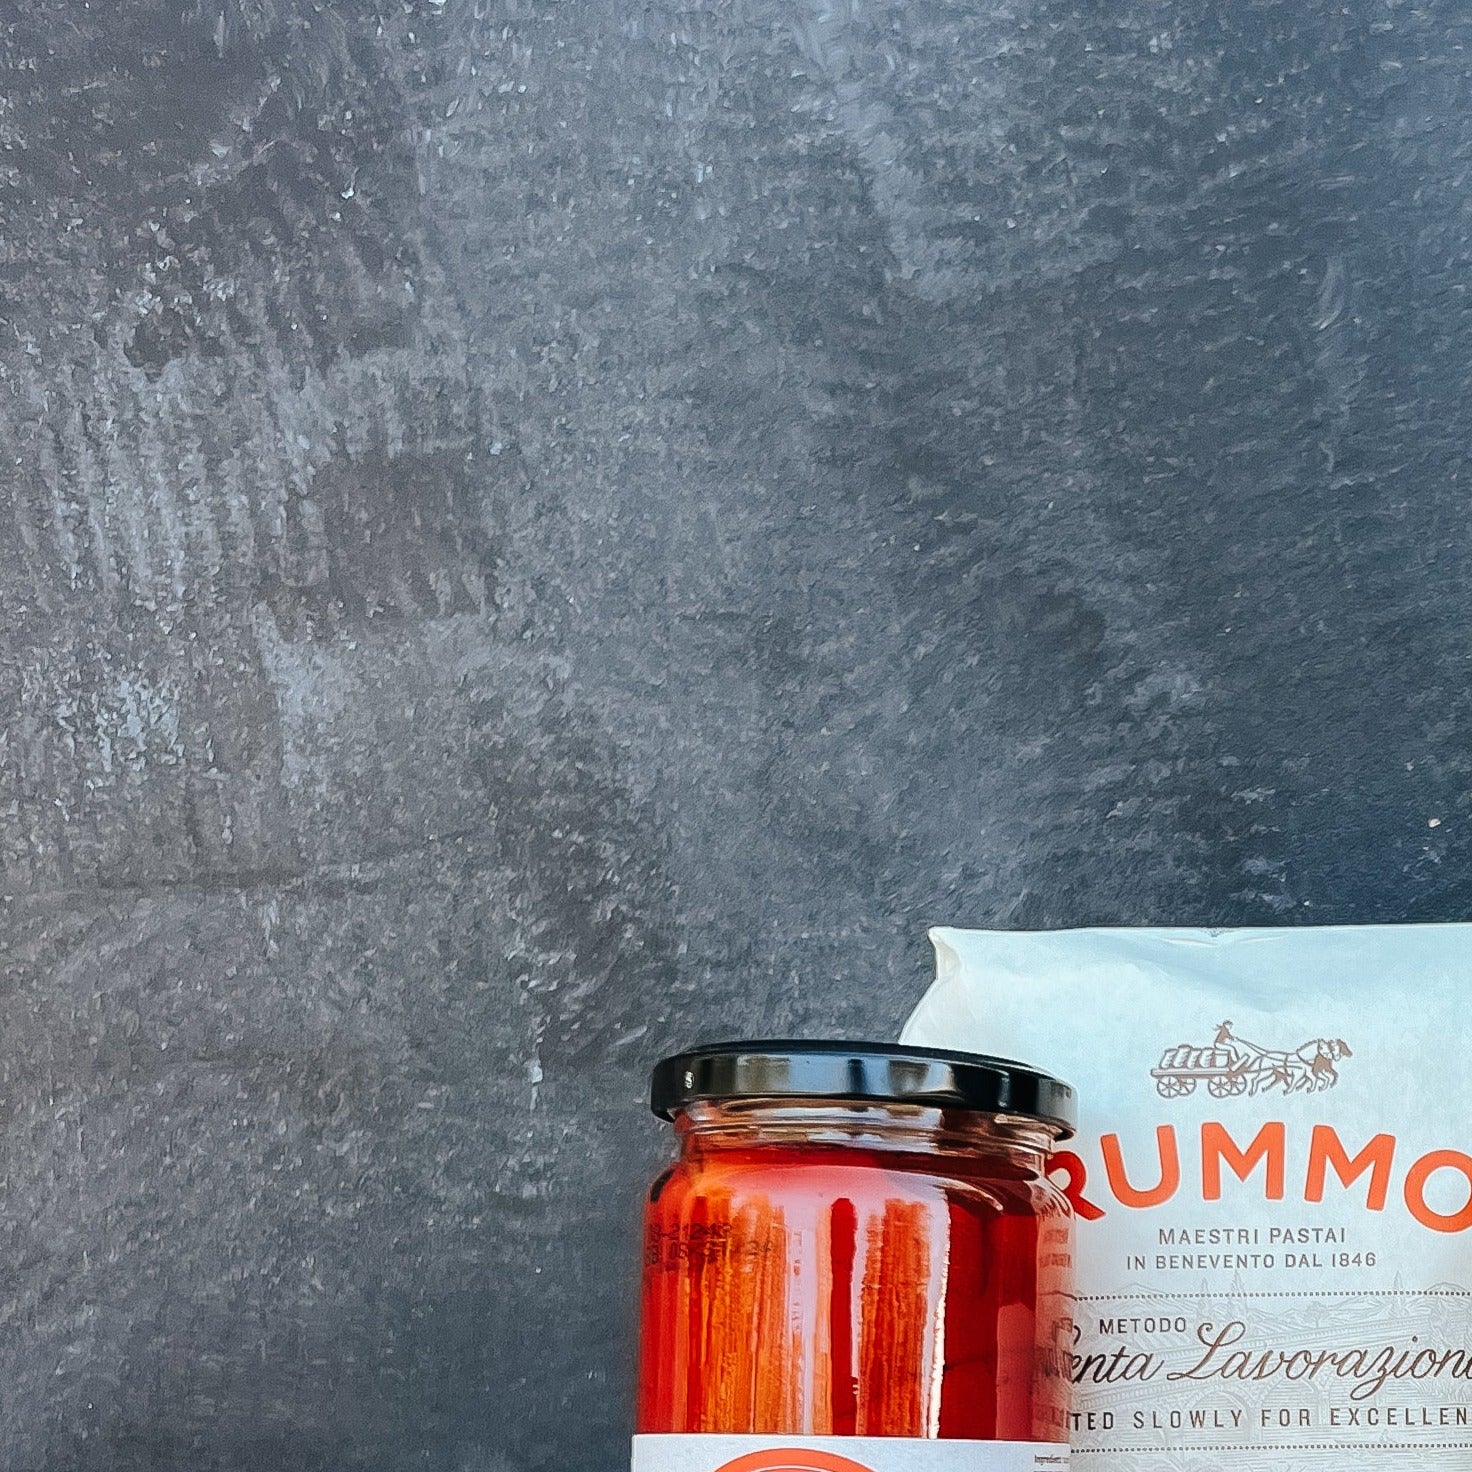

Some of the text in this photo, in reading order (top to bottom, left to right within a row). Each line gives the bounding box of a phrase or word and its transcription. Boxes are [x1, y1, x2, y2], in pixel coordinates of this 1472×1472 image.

[1159, 1228, 1346, 1246] MAESTRI PASTAI
[1126, 1251, 1377, 1271] IN BENEVENTO DAL 1846
[1099, 1317, 1187, 1336] METODO
[1071, 1325, 1165, 1384] enta
[1134, 1409, 1243, 1429] SLOWLY
[1261, 1408, 1311, 1428] FOR
